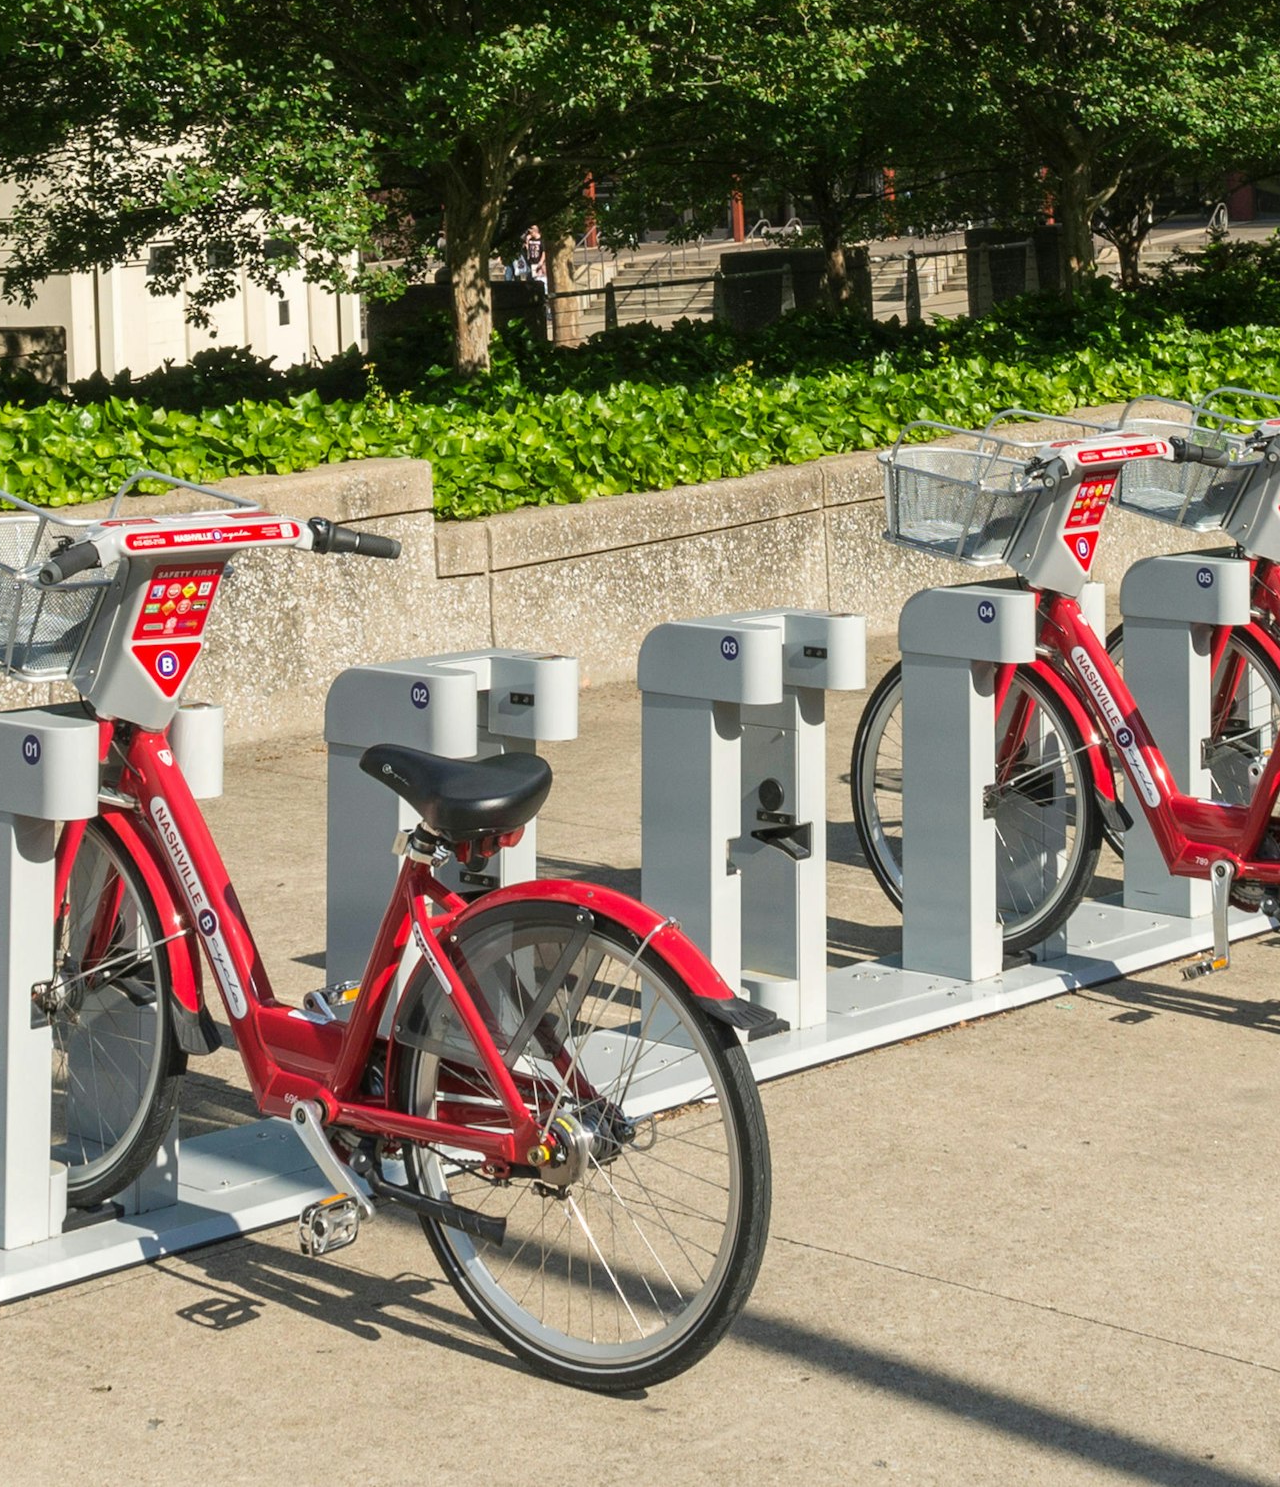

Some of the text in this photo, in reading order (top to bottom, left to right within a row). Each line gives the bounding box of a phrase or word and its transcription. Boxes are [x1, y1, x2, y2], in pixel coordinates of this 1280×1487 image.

[173, 532, 212, 544] NASHVILLE
[1078, 541, 1087, 554] B
[157, 568, 218, 579] SAFETY FIRST
[1198, 572, 1211, 584] 05
[979, 606, 993, 618] 04
[722, 641, 737, 655] 03
[162, 657, 173, 672] B
[412, 688, 427, 703] 02
[1076, 654, 1120, 727] NASHVILLE
[24, 741, 38, 758] 01
[155, 806, 203, 906] NASHVILLE
[1195, 856, 1209, 865] 789
